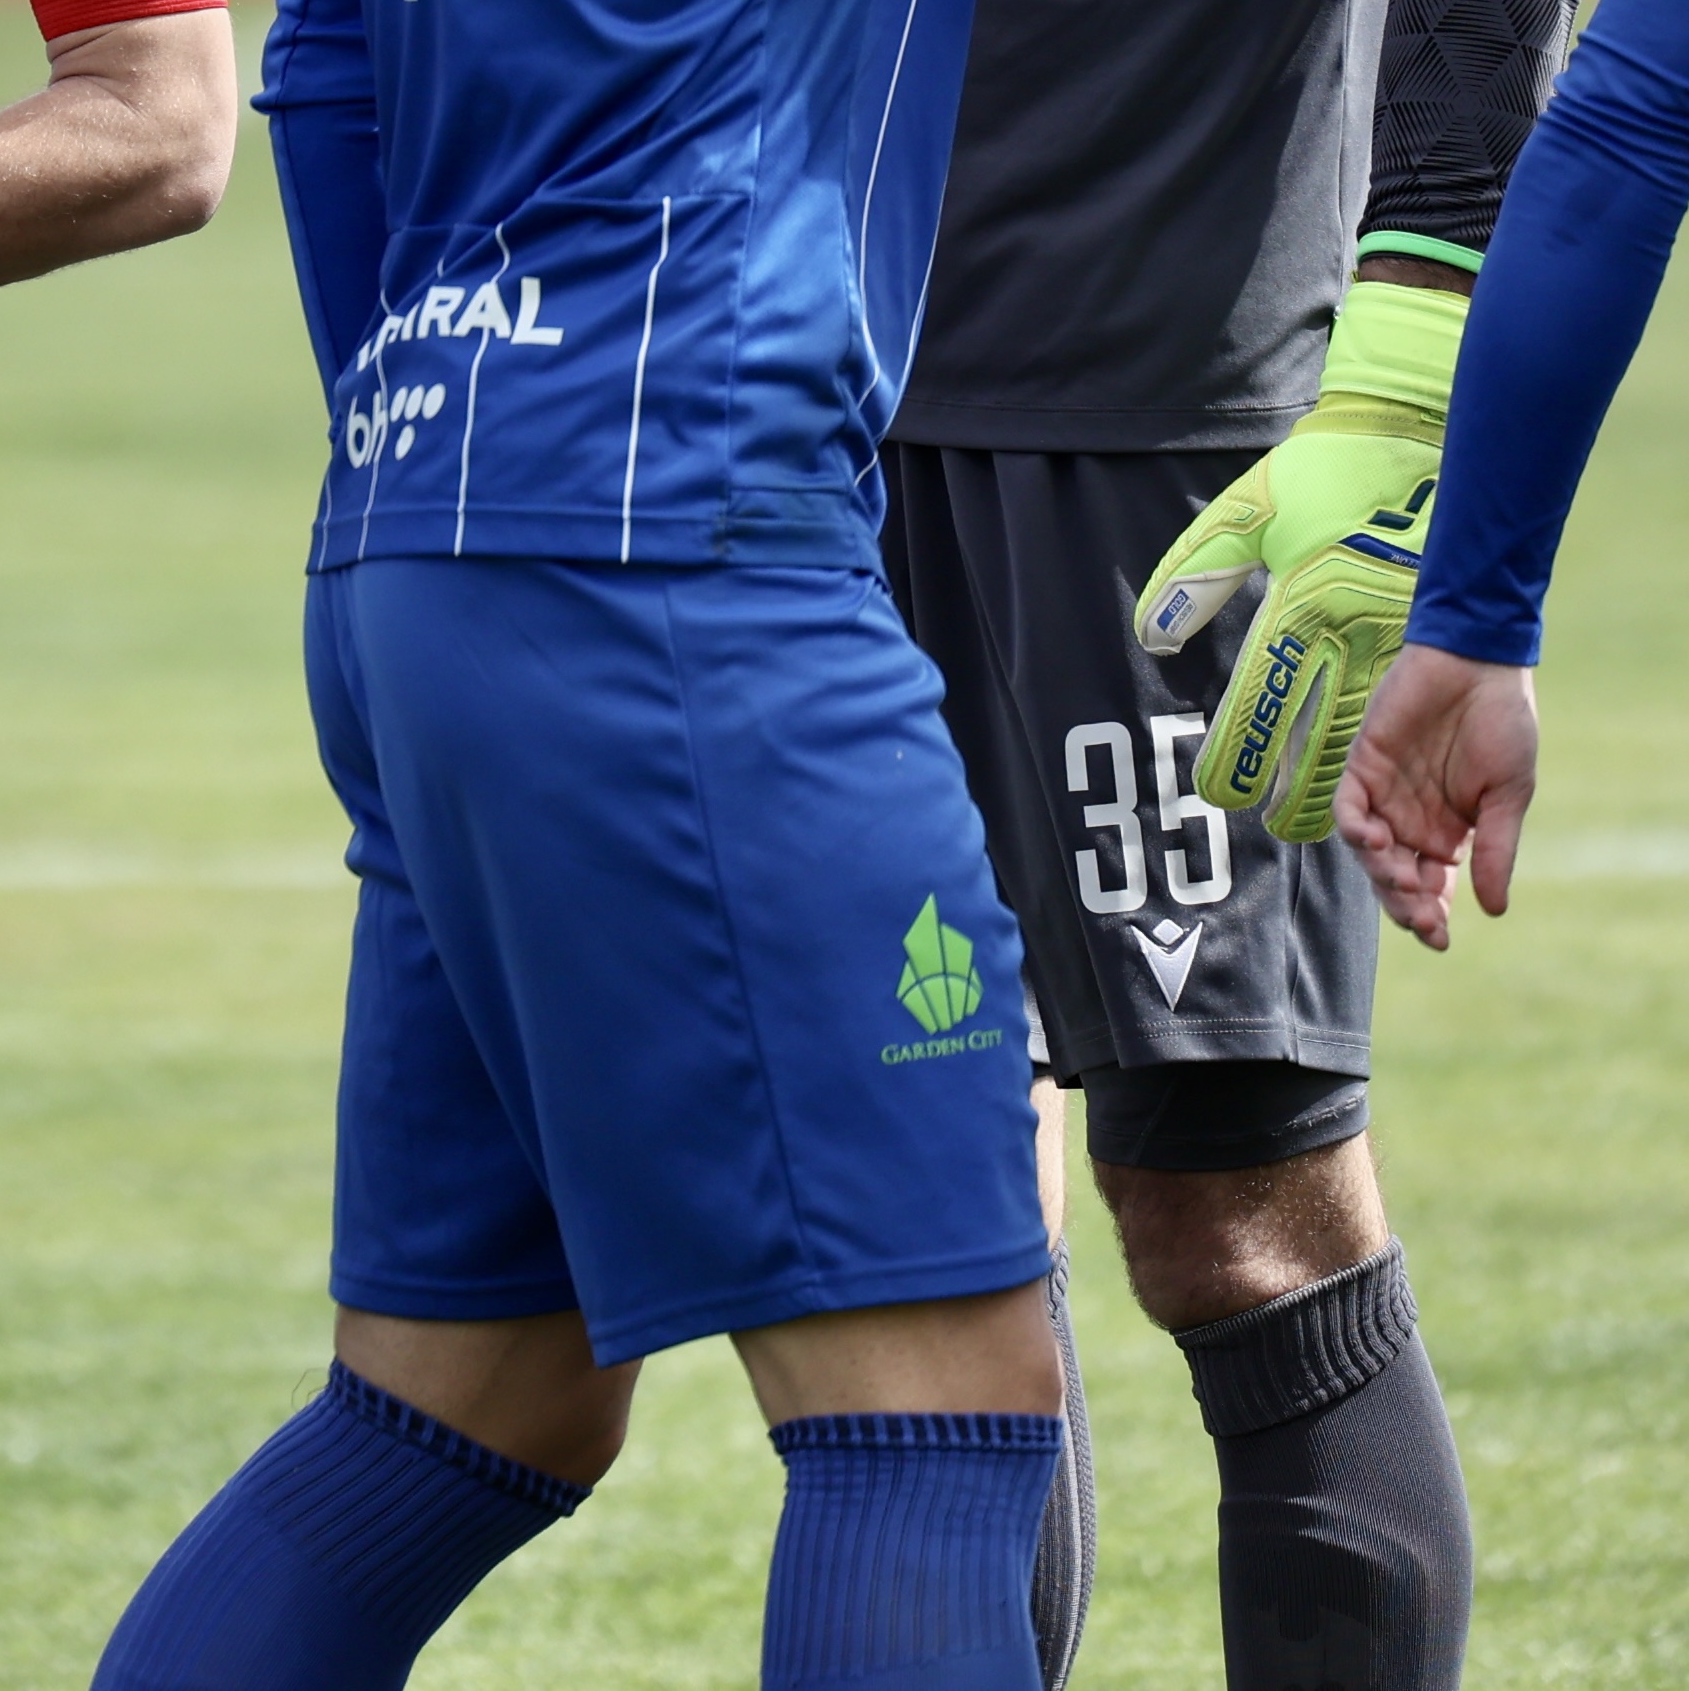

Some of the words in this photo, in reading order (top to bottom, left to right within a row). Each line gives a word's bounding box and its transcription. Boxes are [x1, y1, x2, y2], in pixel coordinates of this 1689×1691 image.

[1167, 593, 1187, 615] GOLD
[1229, 634, 1309, 795] reusch
[1065, 711, 1233, 914] 35
